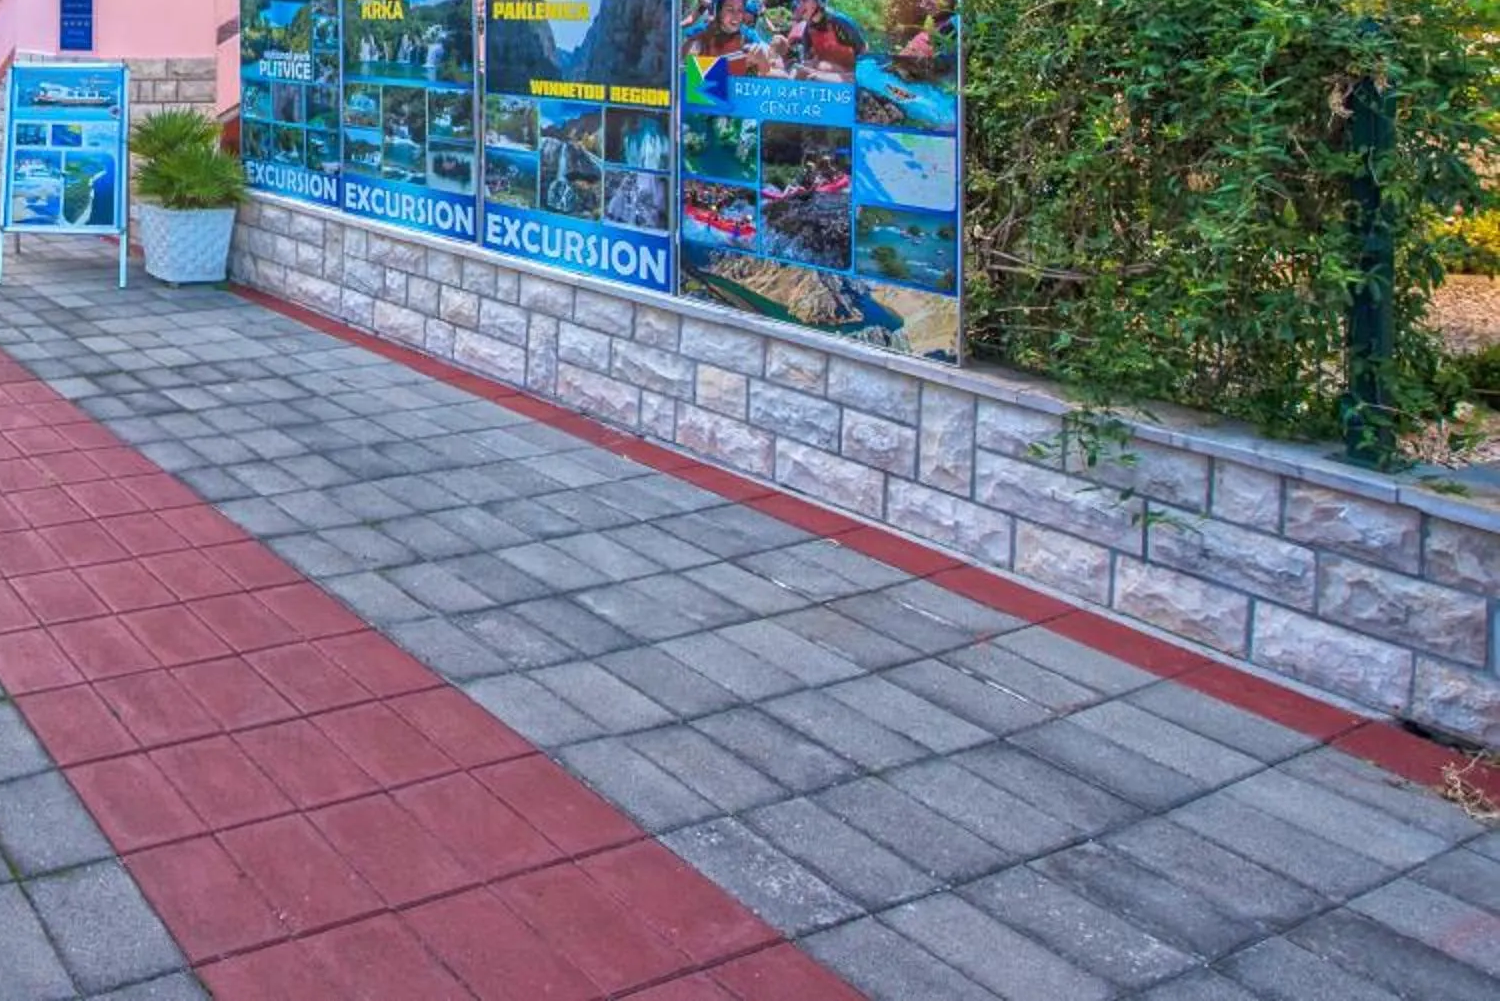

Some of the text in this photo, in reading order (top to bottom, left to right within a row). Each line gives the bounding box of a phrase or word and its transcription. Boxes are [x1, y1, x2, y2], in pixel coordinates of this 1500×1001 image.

[361, 0, 404, 20] KRKA
[492, 1, 590, 21] PAKLENICA
[259, 60, 311, 80] PLITVICE
[529, 78, 670, 107] WINNETOU REGION
[735, 82, 851, 104] RIVA RAFTING
[759, 100, 821, 116] CENTAR
[245, 161, 337, 202] EXCURSION
[344, 181, 474, 236] EXCURSION
[486, 212, 667, 285] EXCURSION
